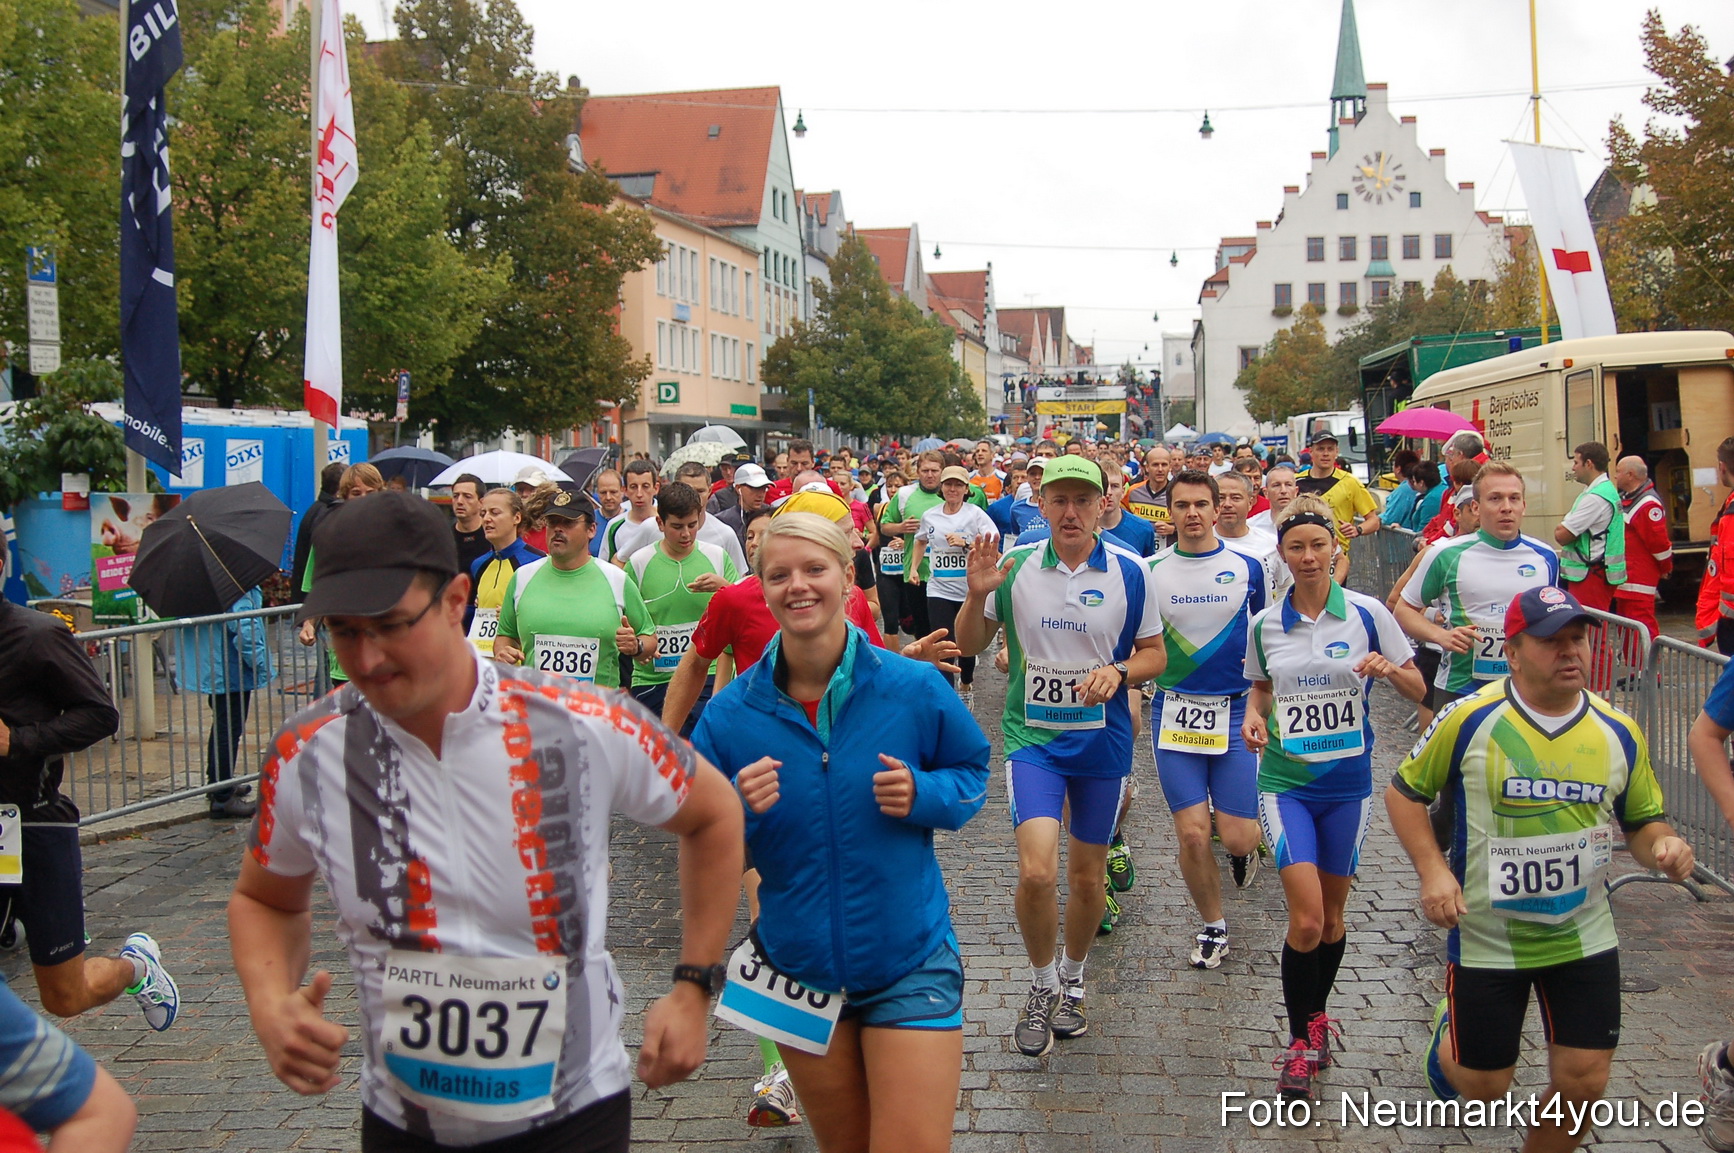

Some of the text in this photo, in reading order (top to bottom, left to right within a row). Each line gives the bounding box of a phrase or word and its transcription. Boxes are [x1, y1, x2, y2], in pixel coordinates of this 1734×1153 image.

[660, 385, 677, 401] D
[1065, 403, 1096, 412] START
[1489, 389, 1539, 416] Bayerisches
[1489, 419, 1513, 438] Rotes
[935, 555, 966, 569] 3096
[1171, 594, 1228, 604] Sebastian
[1547, 604, 1573, 612] adidas
[479, 621, 498, 637] 58
[1041, 617, 1087, 633] Helmut
[557, 641, 588, 649] Neumarkt
[540, 649, 592, 674] 2836
[1028, 663, 1090, 676] PARTL Neumarkt
[1297, 674, 1331, 688] Heidi
[1188, 699, 1219, 707] Neumarkt
[1278, 690, 1347, 704] PARTL Neumarkt
[1046, 709, 1083, 720] Helmut
[1175, 706, 1217, 731] 429
[1287, 700, 1355, 735] 2804
[1172, 733, 1215, 746] Sebastian
[1302, 736, 1345, 751] Heidrun
[1504, 758, 1573, 777] TEAM
[1502, 776, 1608, 804] BOCK
[1491, 843, 1575, 857] PARTL Neumarkt
[1500, 855, 1580, 896] 3051
[388, 966, 536, 992] PARTL Neumarkt
[401, 994, 549, 1060] 3037
[419, 1067, 521, 1099] Matthias
